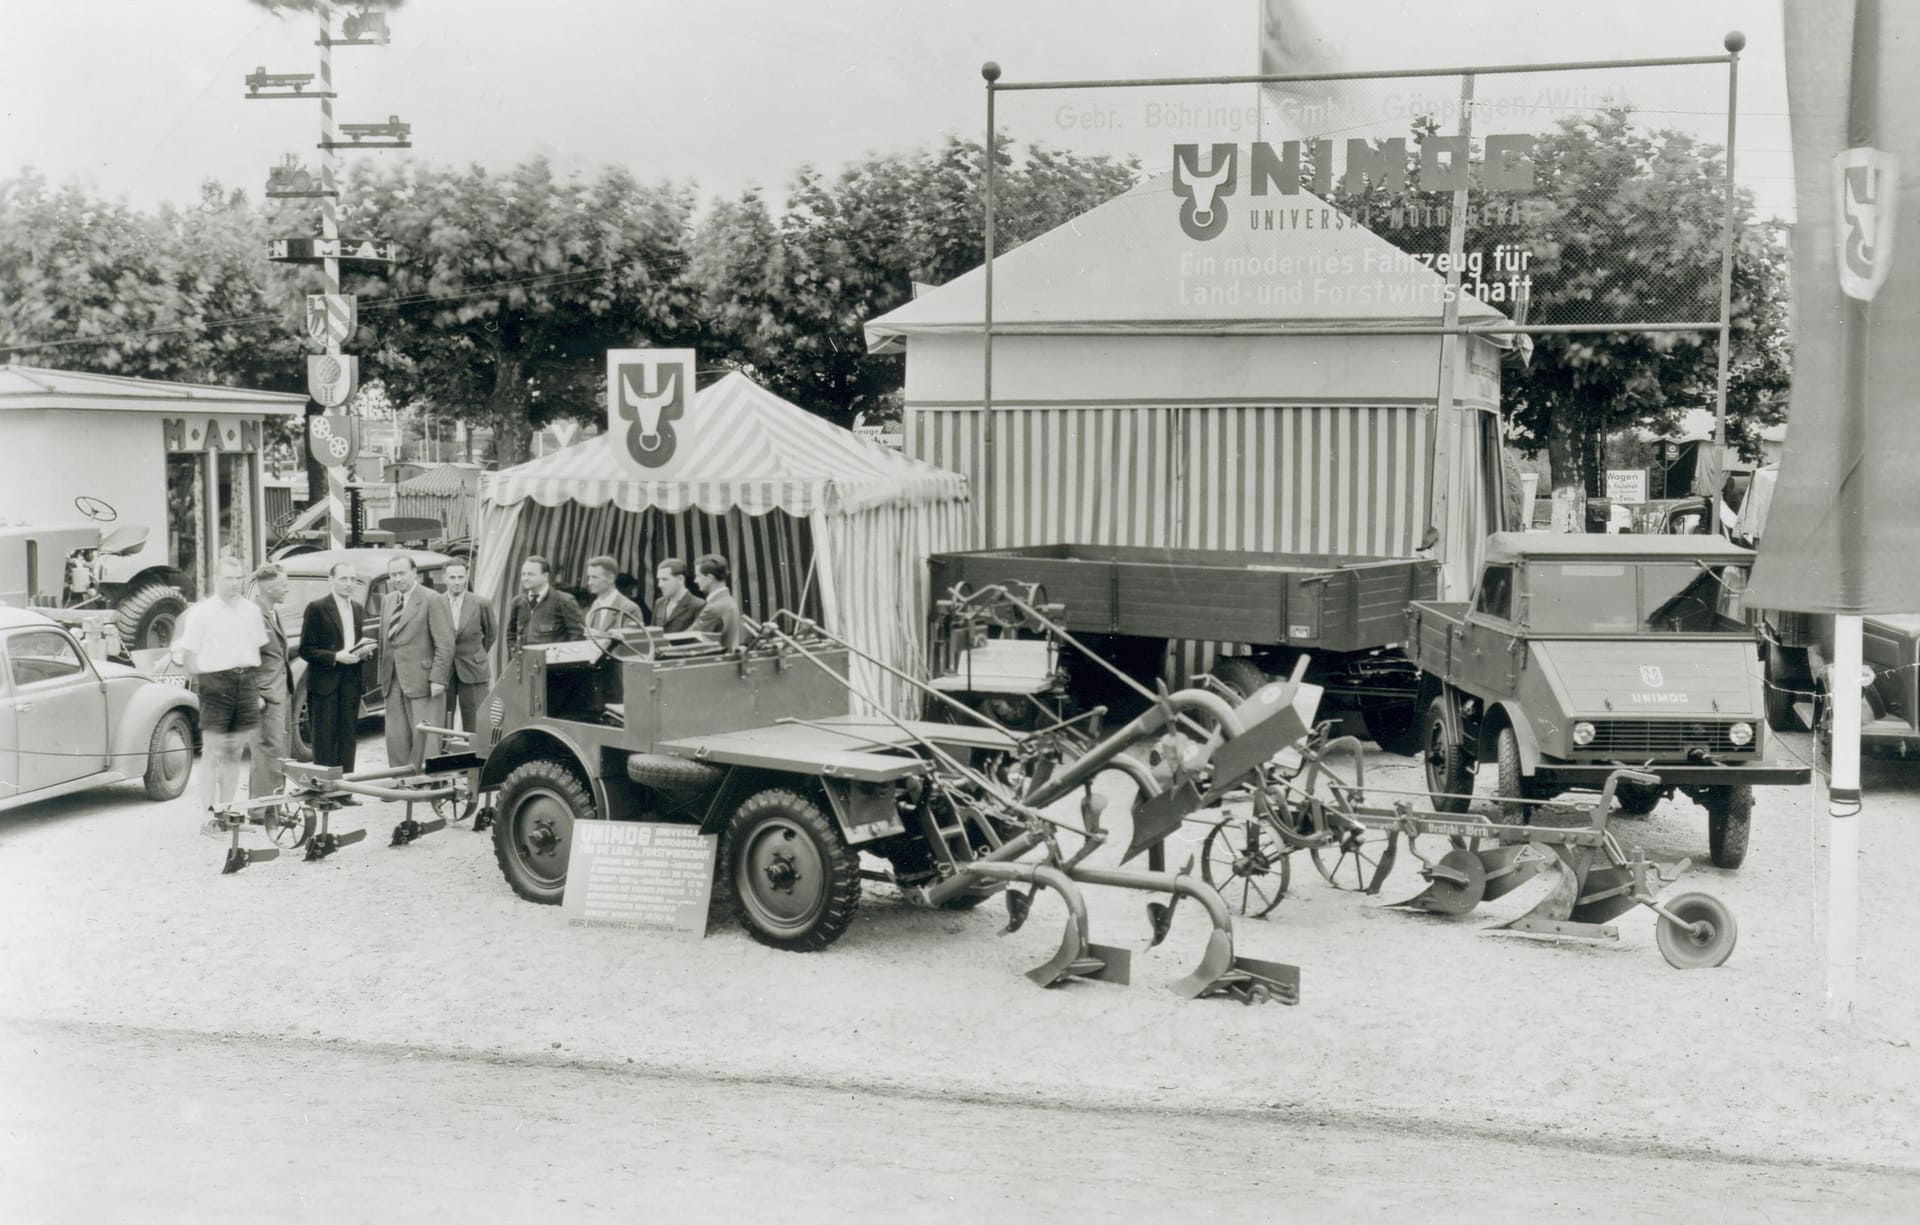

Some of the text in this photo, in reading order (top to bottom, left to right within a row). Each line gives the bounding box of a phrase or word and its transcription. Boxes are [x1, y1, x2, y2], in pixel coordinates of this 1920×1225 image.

[1055, 103, 1122, 130] Gebr.
[1180, 244, 1534, 278] Ein modernes Fahrzeug für
[1313, 275, 1534, 305] Forstwirtschaft
[1608, 472, 1638, 482] Wagen
[1632, 692, 1689, 704] UNIMOG
